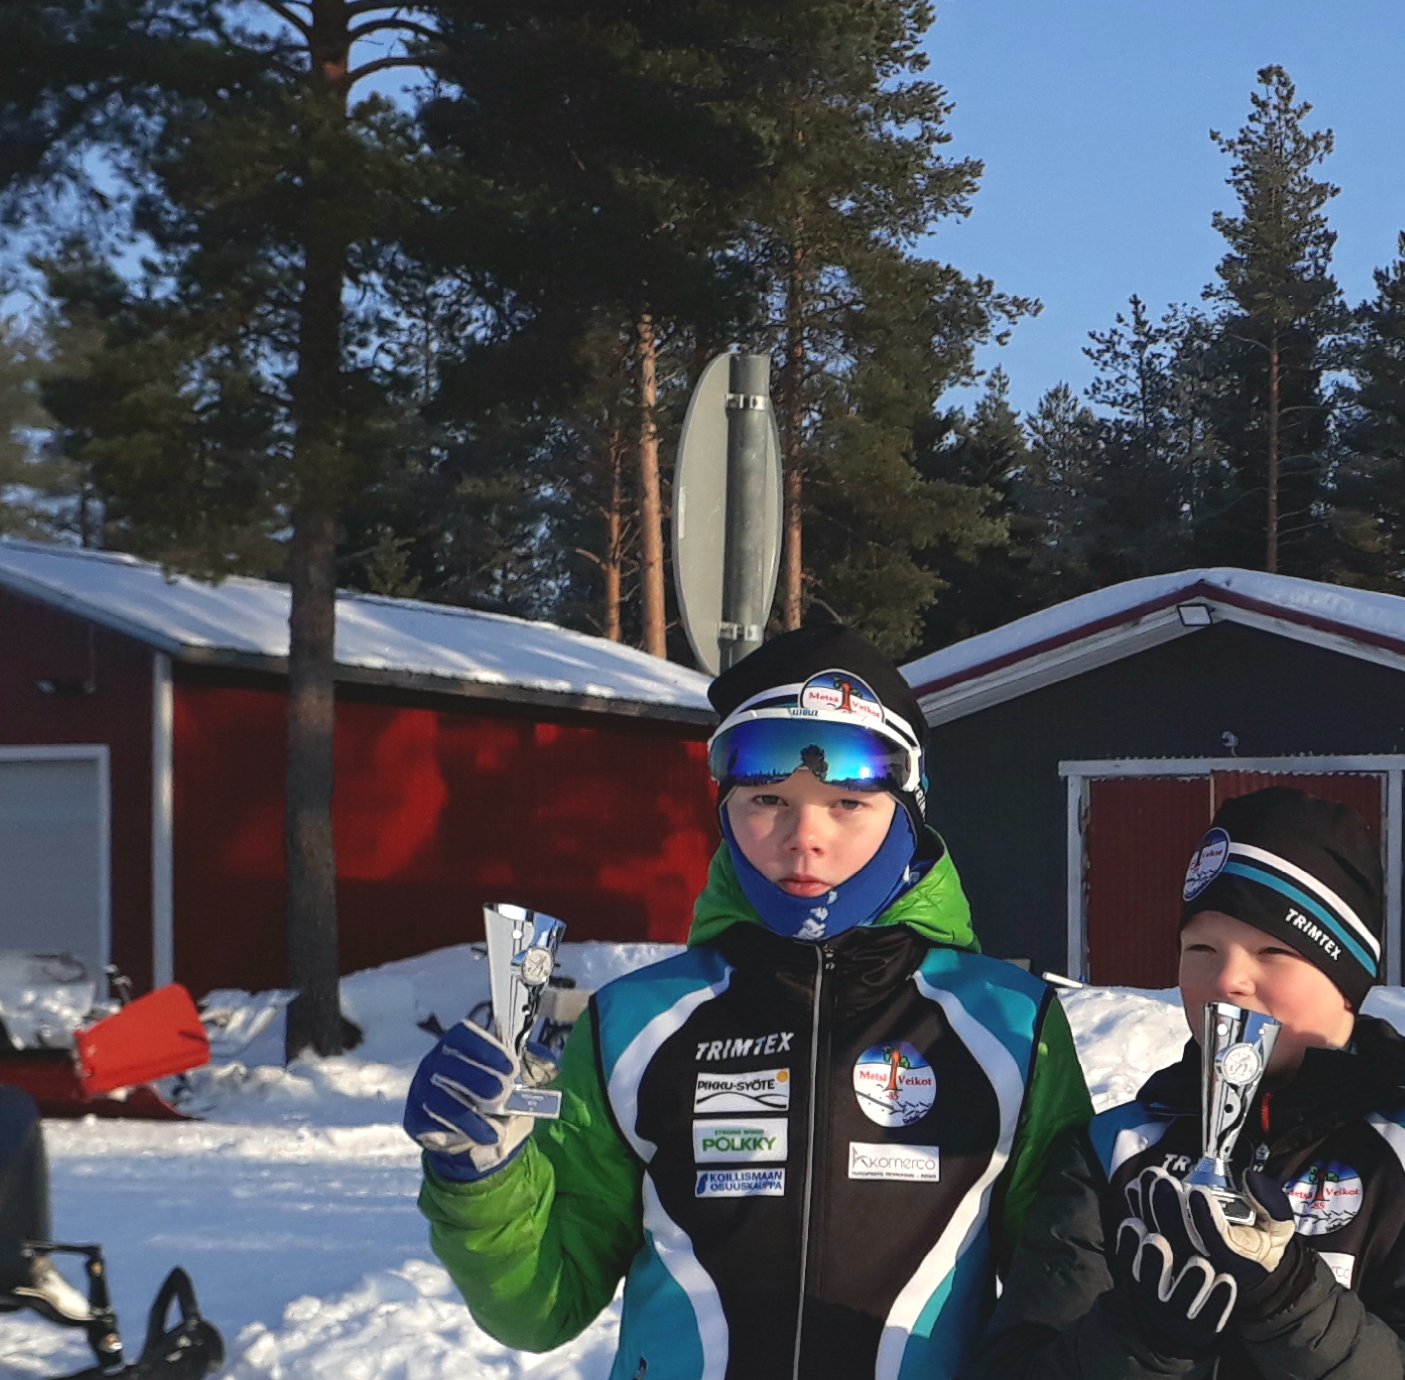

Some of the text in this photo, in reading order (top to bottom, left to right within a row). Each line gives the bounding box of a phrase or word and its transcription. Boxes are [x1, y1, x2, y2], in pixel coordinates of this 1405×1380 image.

[1285, 907, 1342, 961] TRIMTEX
[695, 1031, 795, 1061] TRIMTEX
[697, 1078, 775, 1091] PIKKU-SYÖTE
[709, 1171, 783, 1182] KOILLISMAAN
[709, 1181, 783, 1192] OSUUSKAUPPA
